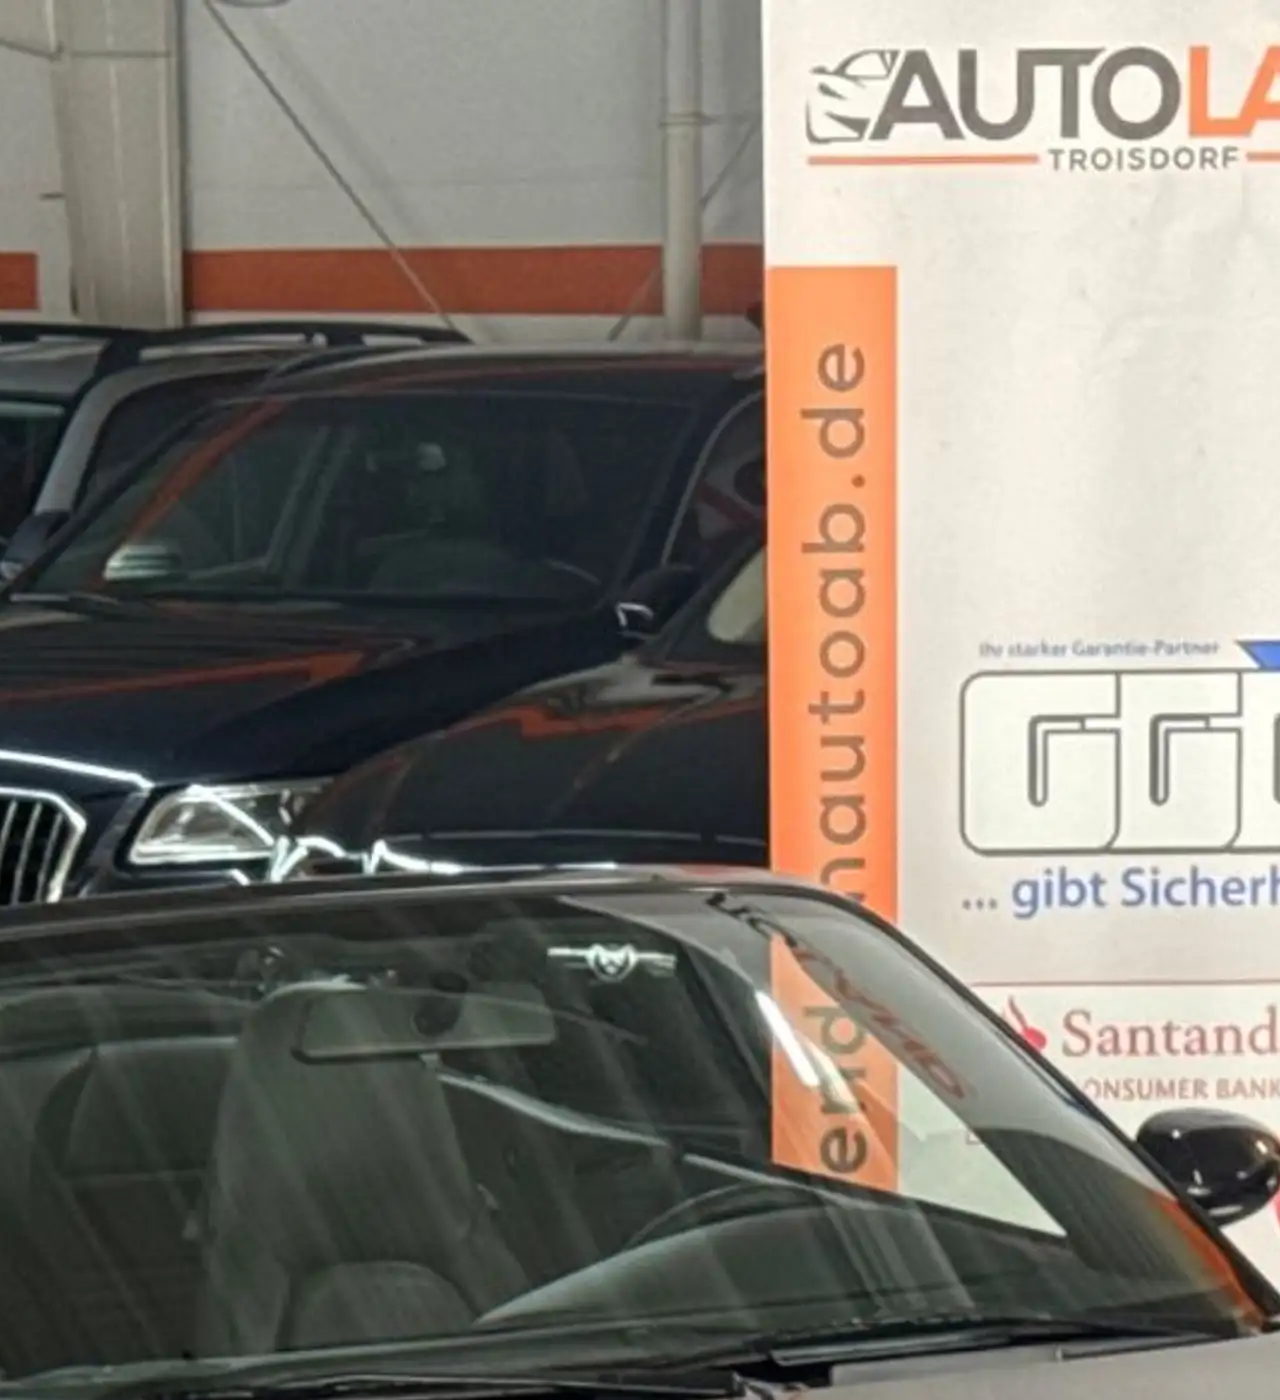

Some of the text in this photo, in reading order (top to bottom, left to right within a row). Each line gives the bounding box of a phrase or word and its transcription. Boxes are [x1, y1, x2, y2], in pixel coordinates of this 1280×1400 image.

[1049, 146, 1239, 172] TROISDORF
[1012, 867, 1108, 919] gibt
[1082, 1077, 1209, 1102] ONSUMER
